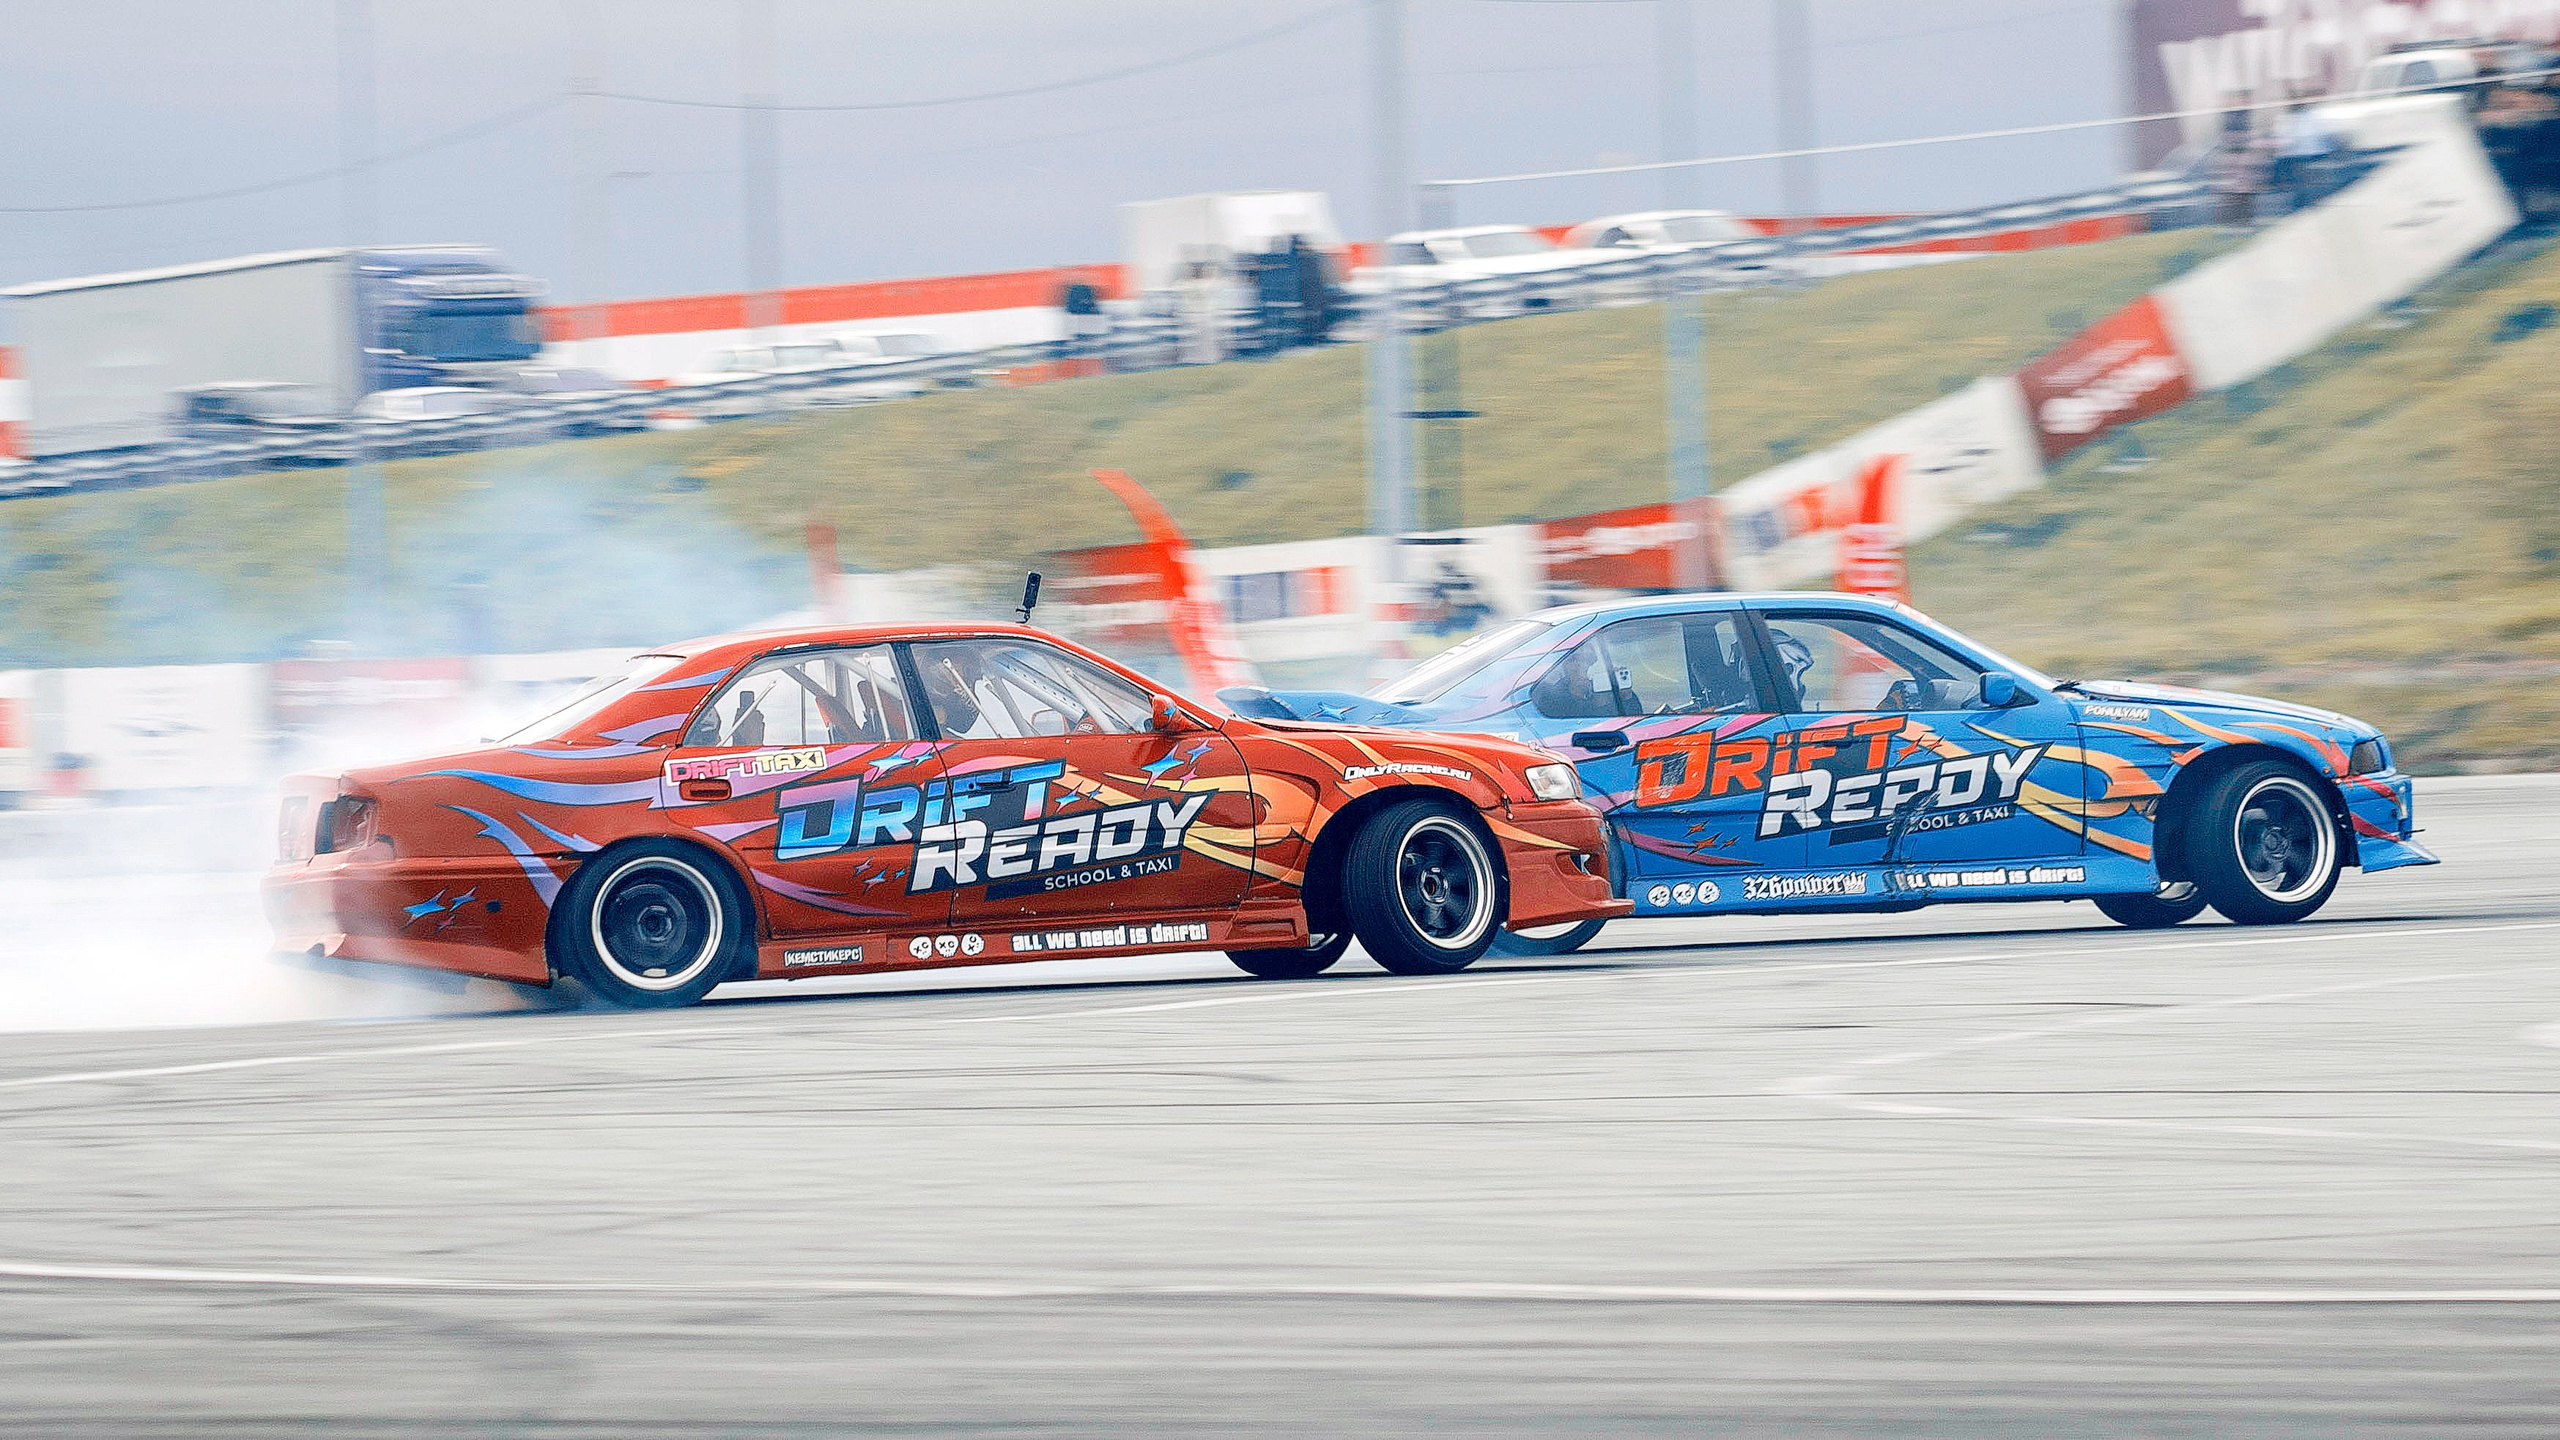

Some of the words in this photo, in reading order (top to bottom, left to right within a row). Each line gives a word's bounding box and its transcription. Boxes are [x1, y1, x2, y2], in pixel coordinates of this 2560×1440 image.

[1958, 812, 1970, 825] &
[1972, 805, 2009, 822] TAXI
[910, 794, 1208, 892] READY
[1045, 869, 1115, 890] SCHOOL
[1120, 865, 1132, 878] &
[1136, 856, 1172, 875] TAXI
[1080, 925, 1126, 947] need
